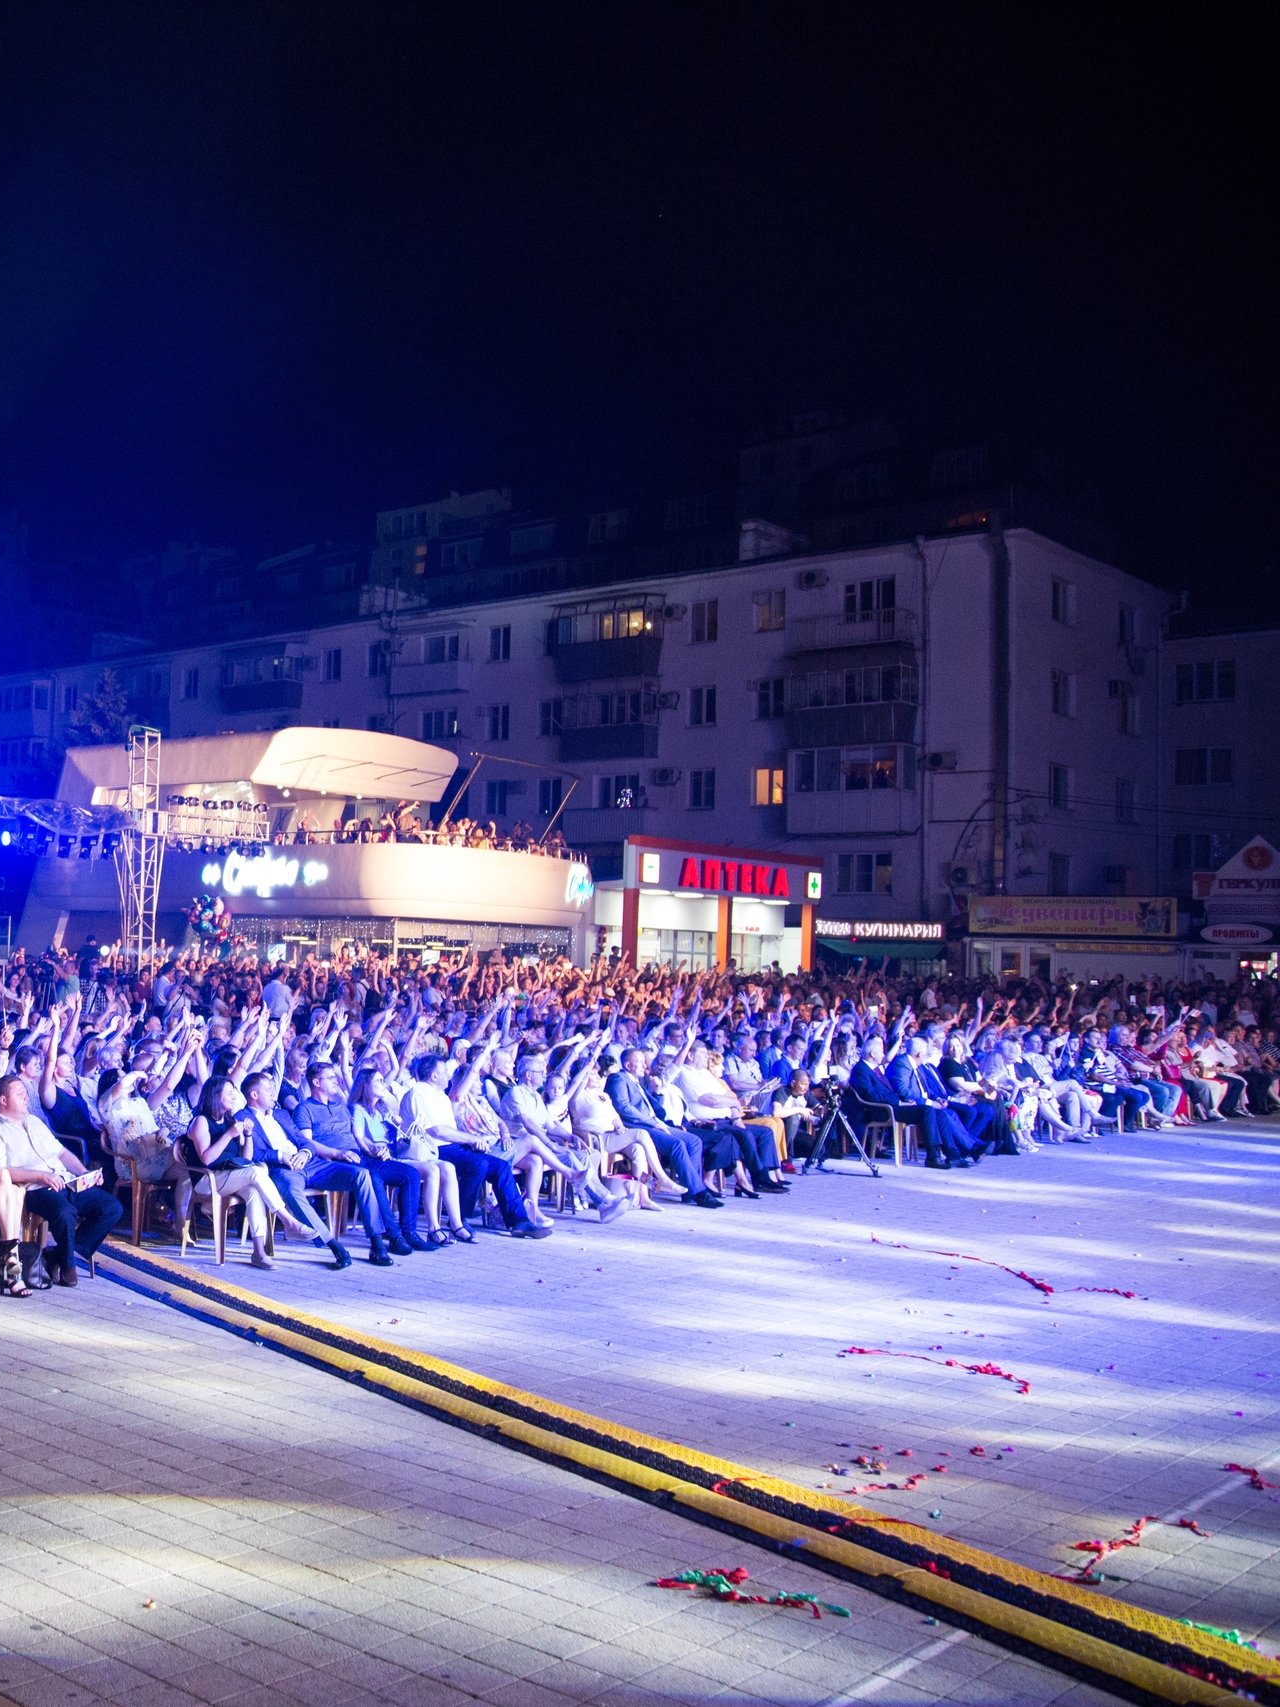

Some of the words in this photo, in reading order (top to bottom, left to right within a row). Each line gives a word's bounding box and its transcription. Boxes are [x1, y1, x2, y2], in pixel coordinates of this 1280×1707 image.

[678, 857, 789, 897] АПТЕКА
[1218, 878, 1280, 891] ГЕРКУЛ
[854, 922, 942, 938] КУЛИНАРИЯ
[1064, 926, 1118, 934] БИЖУТЕРИЯ
[1212, 929, 1259, 939] ПРОДУКТЫ
